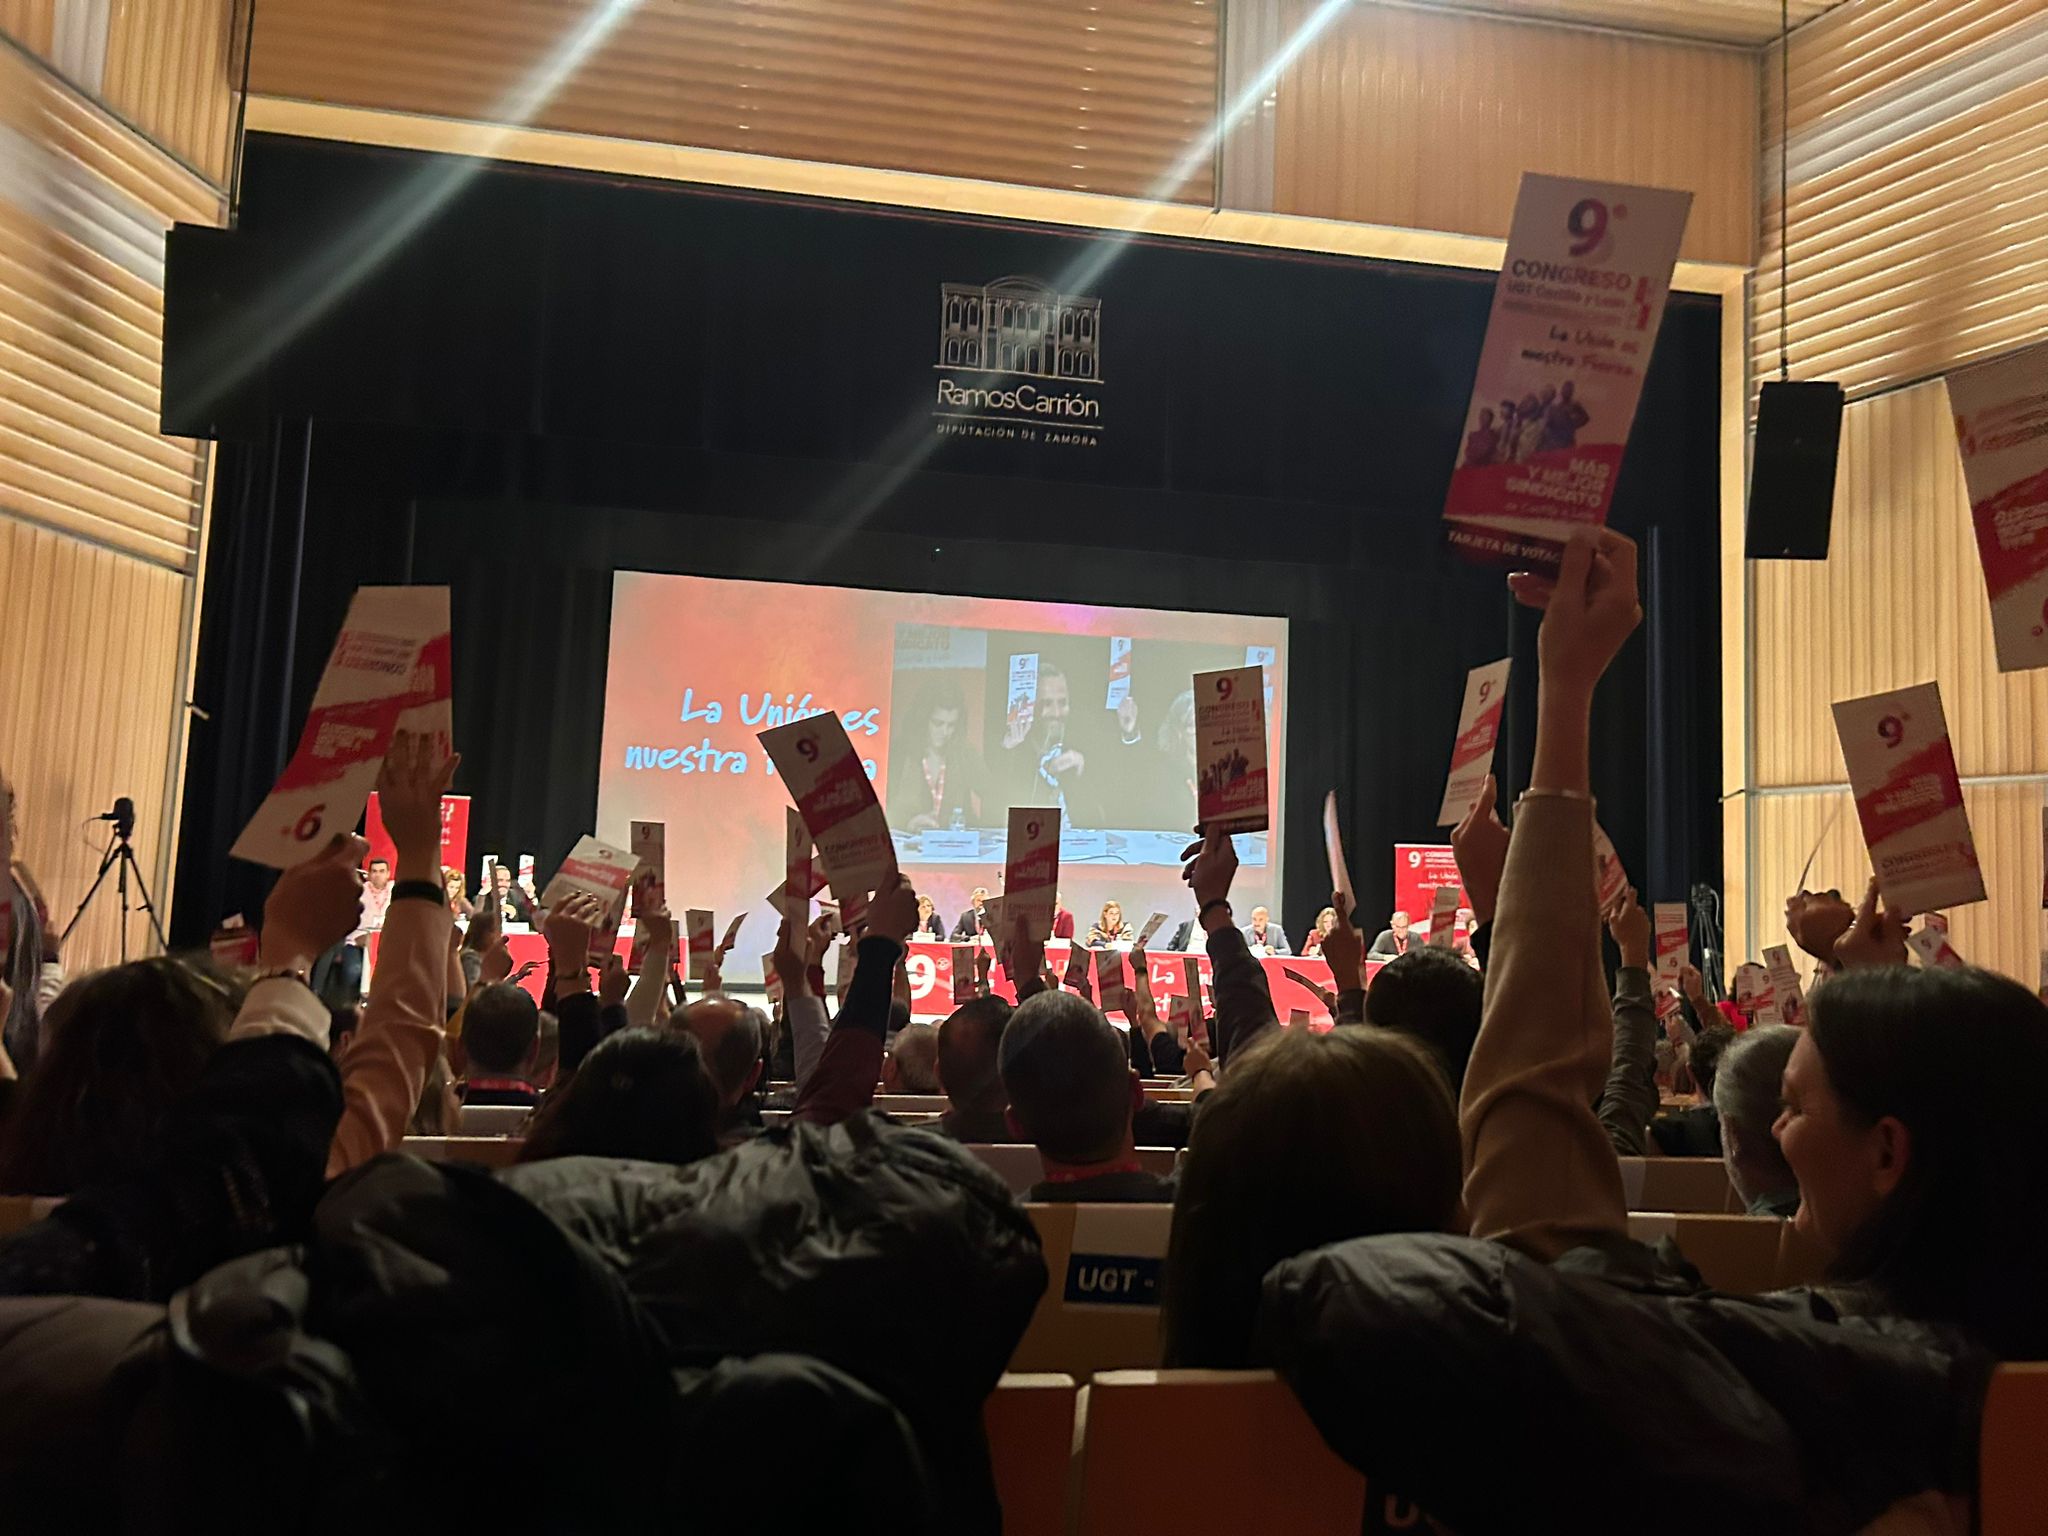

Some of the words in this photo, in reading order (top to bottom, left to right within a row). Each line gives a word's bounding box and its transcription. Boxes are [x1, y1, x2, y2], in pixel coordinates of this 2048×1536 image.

[1512, 259, 1632, 291] CONGRESO
[937, 378, 1100, 419] RamosCarrión
[1021, 428, 1036, 441] DE
[1044, 432, 1097, 447] ZAMORA
[1447, 529, 1500, 551] TARJETA
[1500, 540, 1520, 556] DE
[1520, 545, 1561, 564] VOTAC
[680, 687, 722, 724] La
[840, 706, 880, 735] es
[623, 737, 747, 774] nuestra
[1152, 964, 1175, 985] La
[1078, 1263, 1139, 1294] UGT
